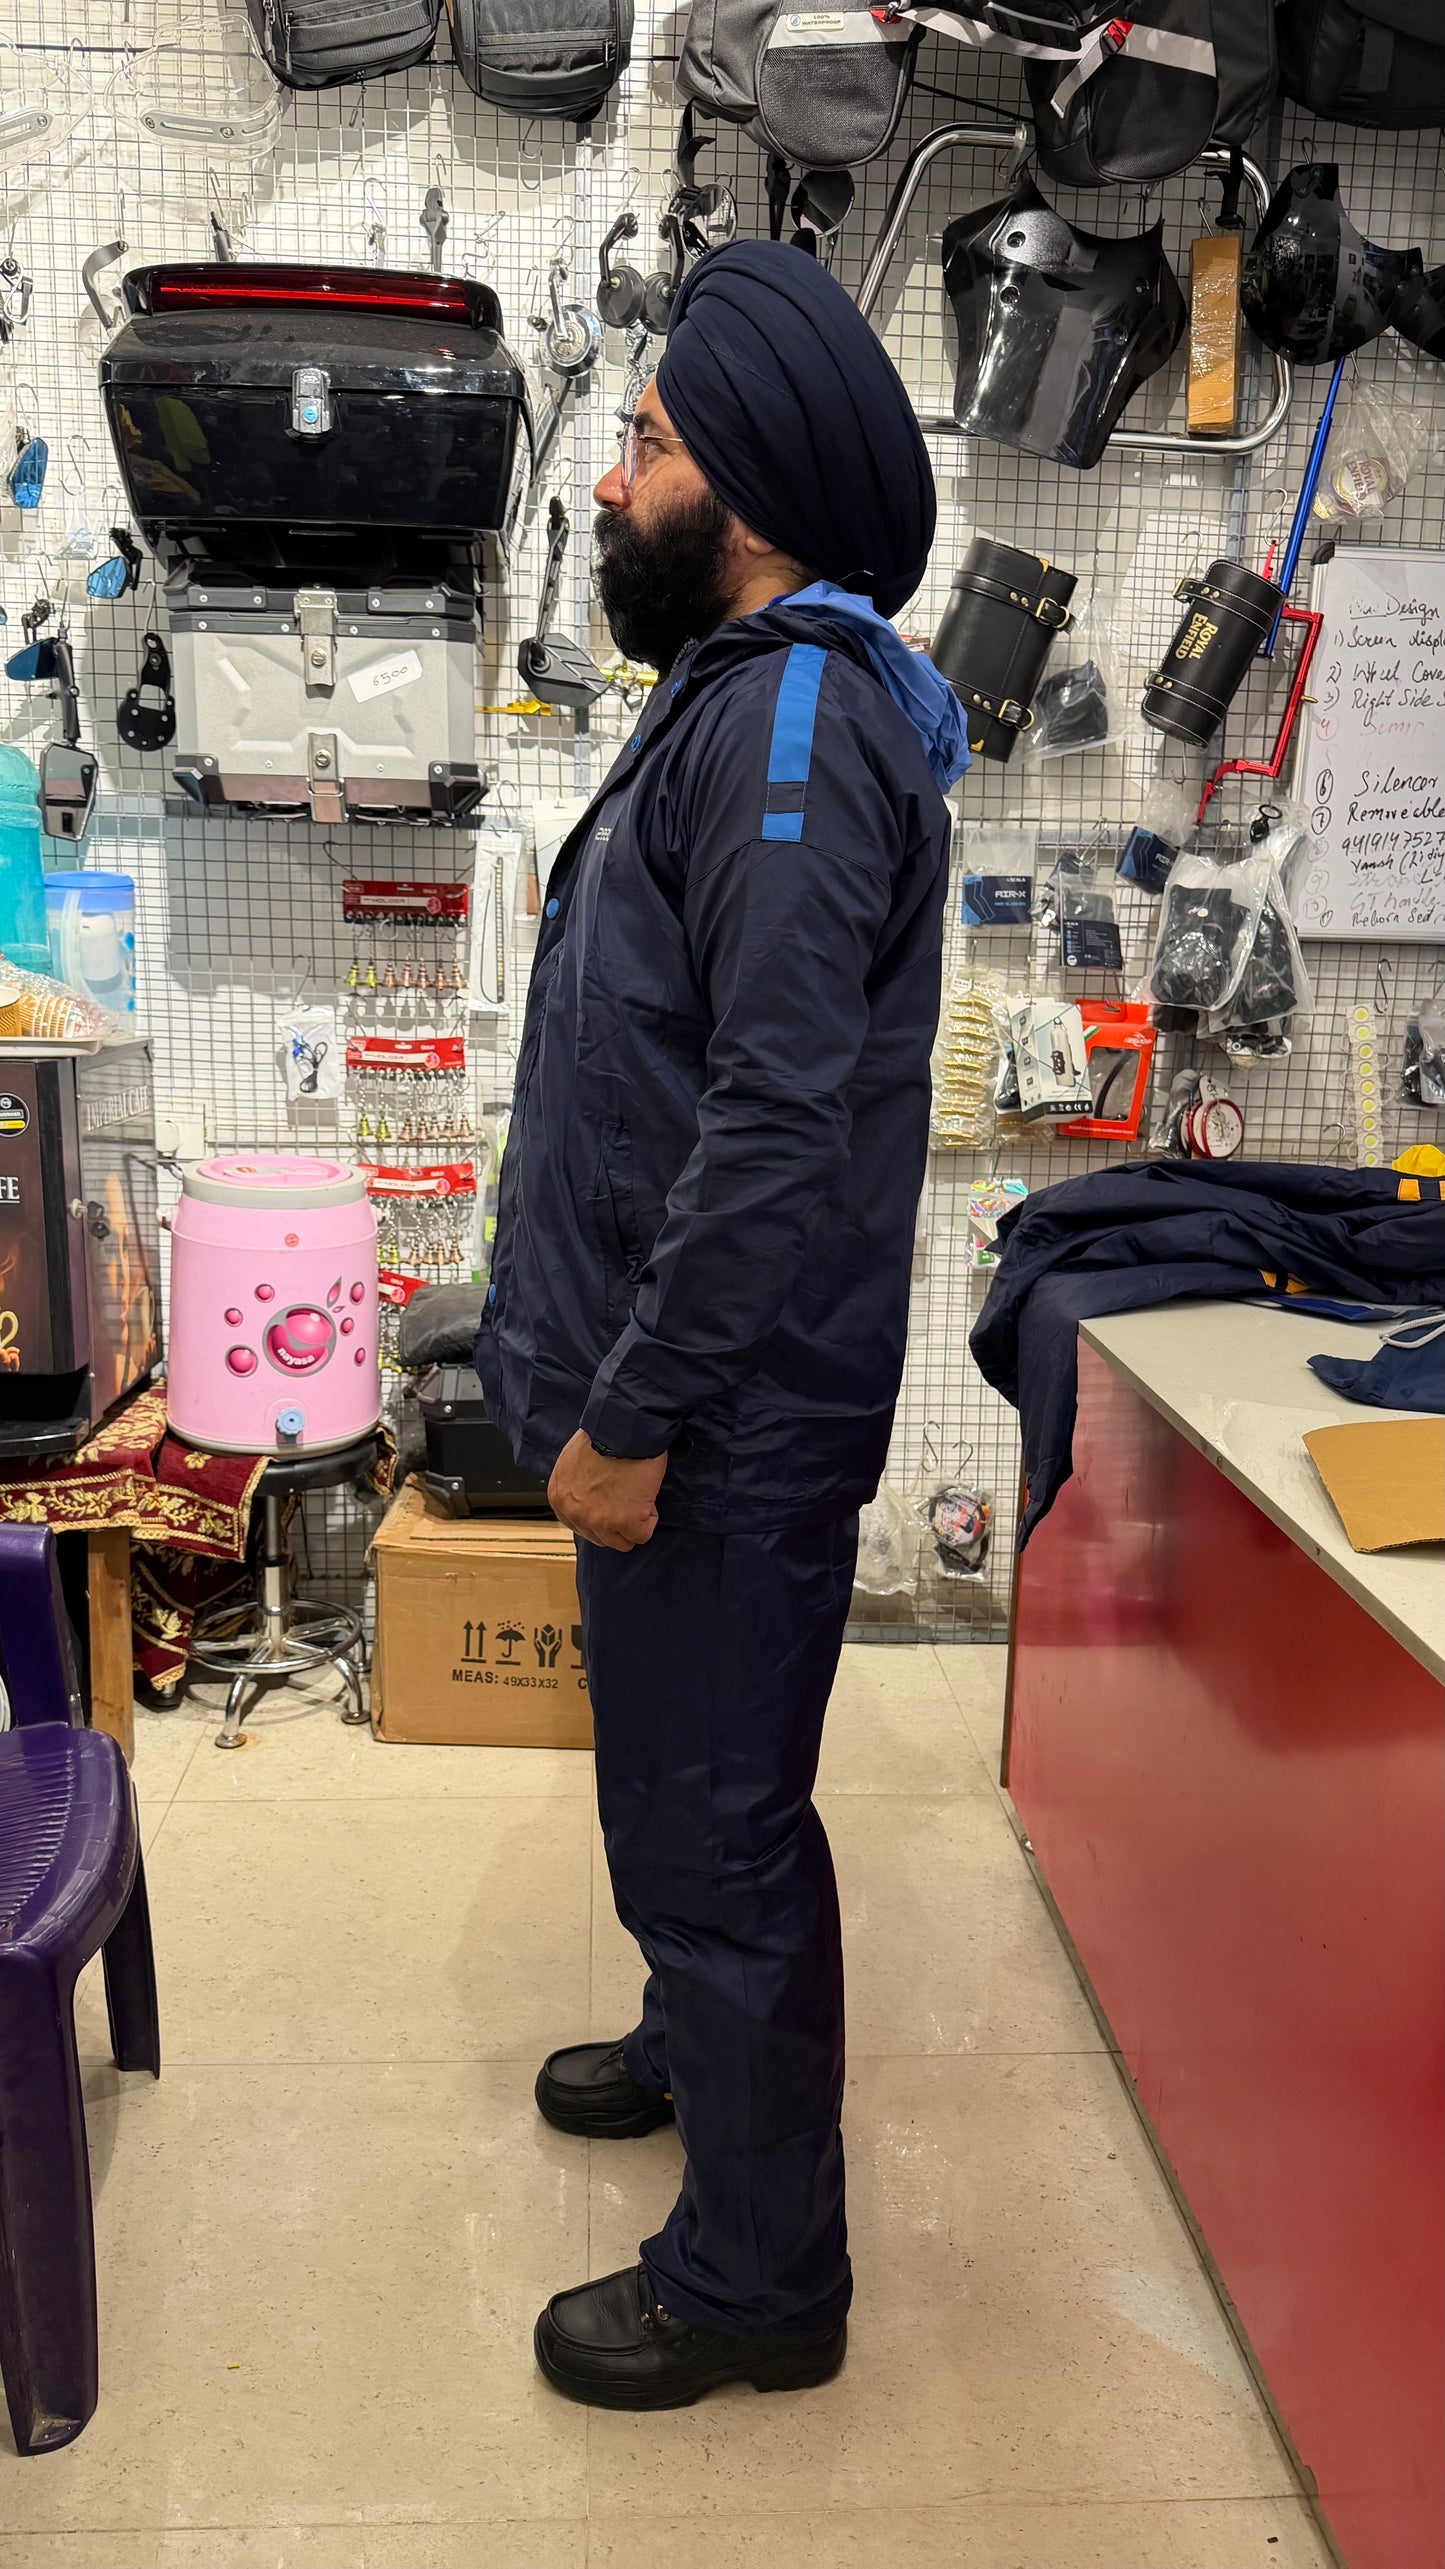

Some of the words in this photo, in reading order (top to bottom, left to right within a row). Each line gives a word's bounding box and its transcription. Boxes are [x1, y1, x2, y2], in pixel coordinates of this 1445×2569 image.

[1358, 460, 1377, 494] ROYAL
[1386, 592, 1440, 627] Design
[1175, 612, 1208, 660] ENFIELD
[1188, 622, 1219, 659] ROYAL
[373, 666, 408, 686] 6500
[995, 890, 1026, 898] AIR-X
[277, 1347, 315, 1365] nayasa
[452, 1669, 499, 1684] MEAS:
